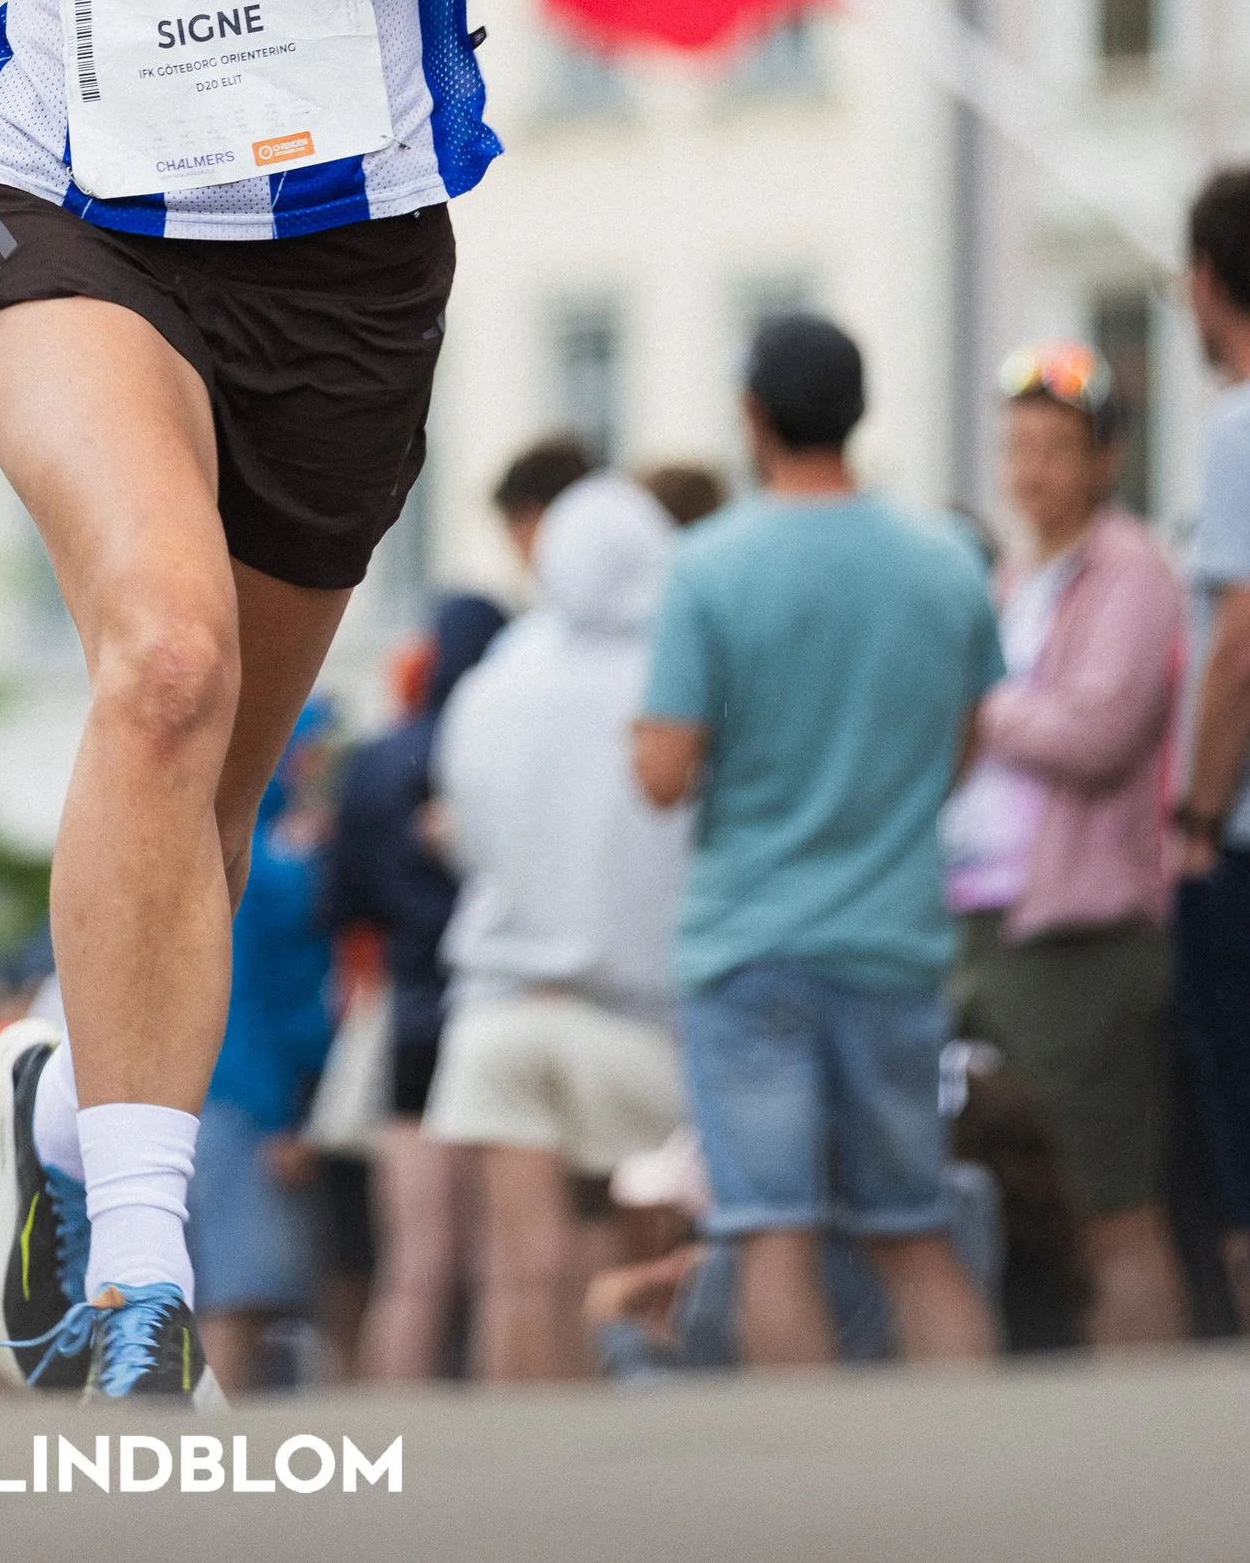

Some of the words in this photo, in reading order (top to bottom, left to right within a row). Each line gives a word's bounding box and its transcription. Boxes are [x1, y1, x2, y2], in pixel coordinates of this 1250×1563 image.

[157, 3, 264, 49] SIGNE
[138, 68, 155, 79] IFK
[156, 57, 218, 77] GÖTEBORG
[220, 42, 297, 65] ORIENTERING
[195, 79, 219, 93] D20
[221, 74, 242, 88] ELIT
[155, 150, 236, 173] CHALMERS
